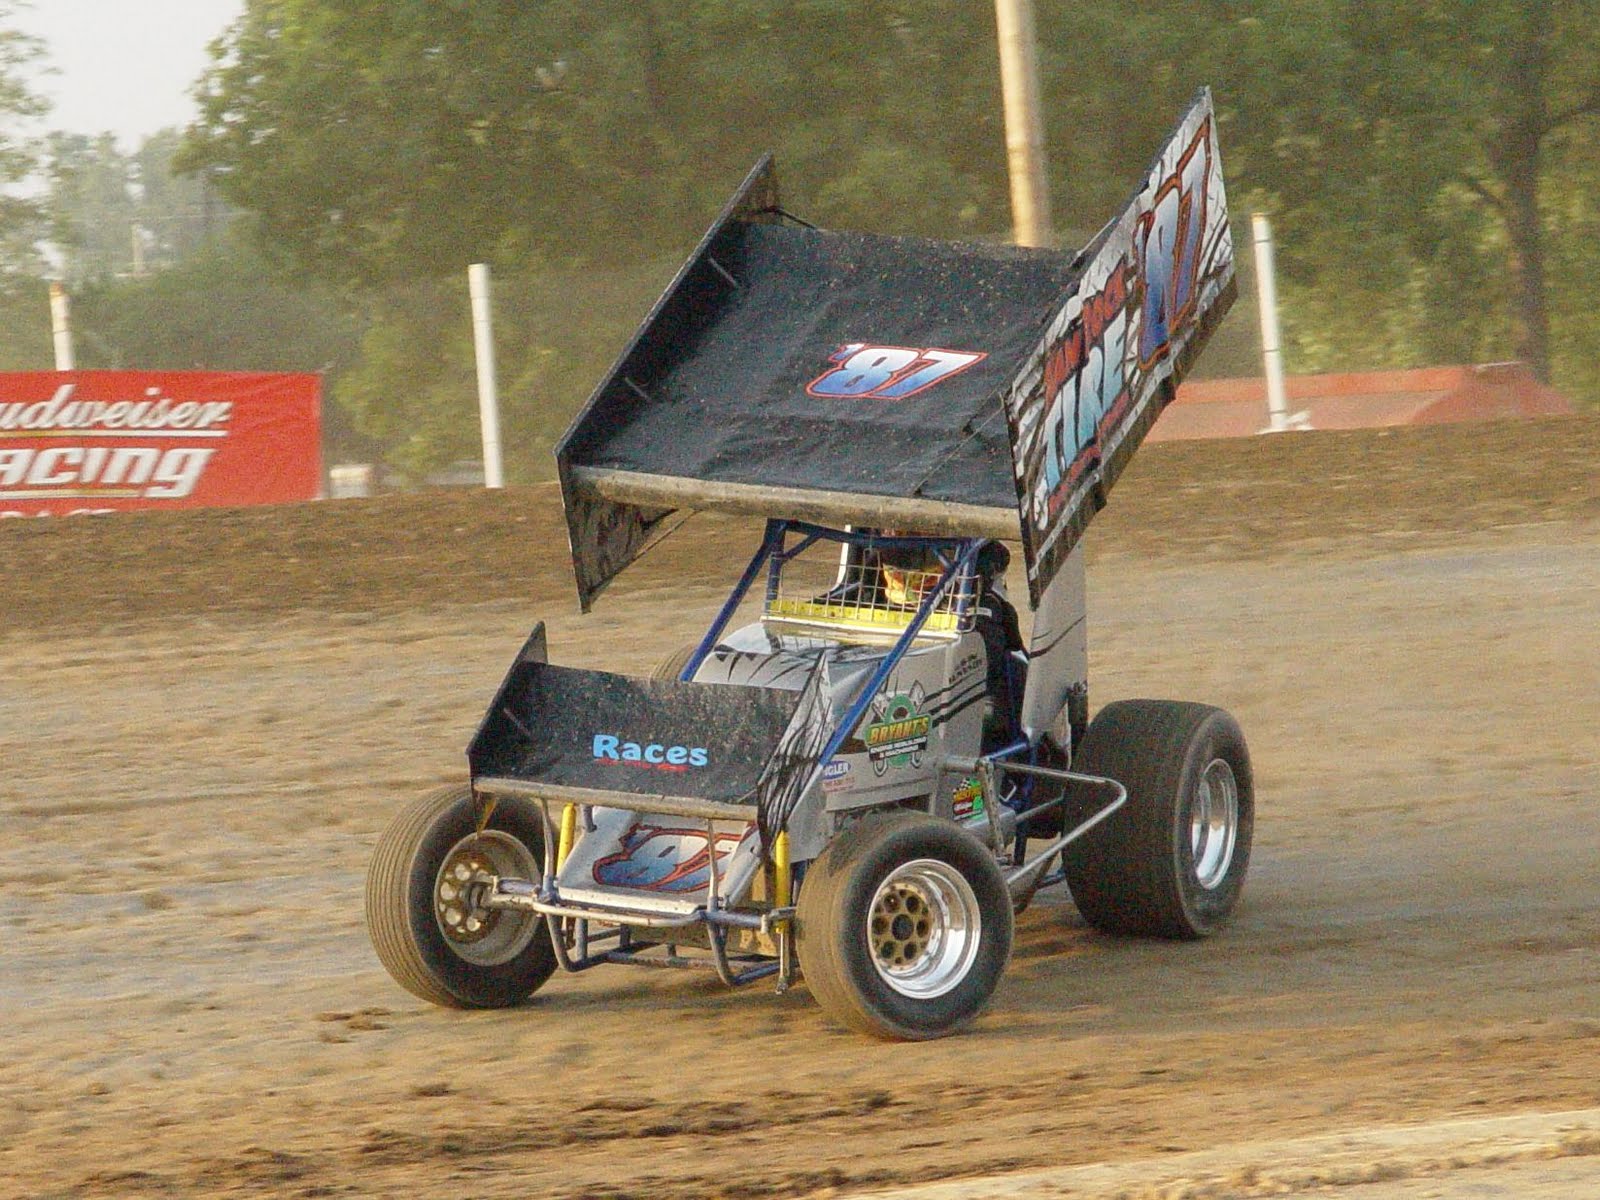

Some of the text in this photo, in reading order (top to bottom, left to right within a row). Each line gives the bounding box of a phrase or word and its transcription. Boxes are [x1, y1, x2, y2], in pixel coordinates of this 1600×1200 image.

[0, 384, 234, 429] udweiser
[1042, 306, 1126, 494] TIRE
[0, 447, 216, 498] acing
[592, 733, 708, 767] Races
[870, 716, 930, 744] BRYANT'S
